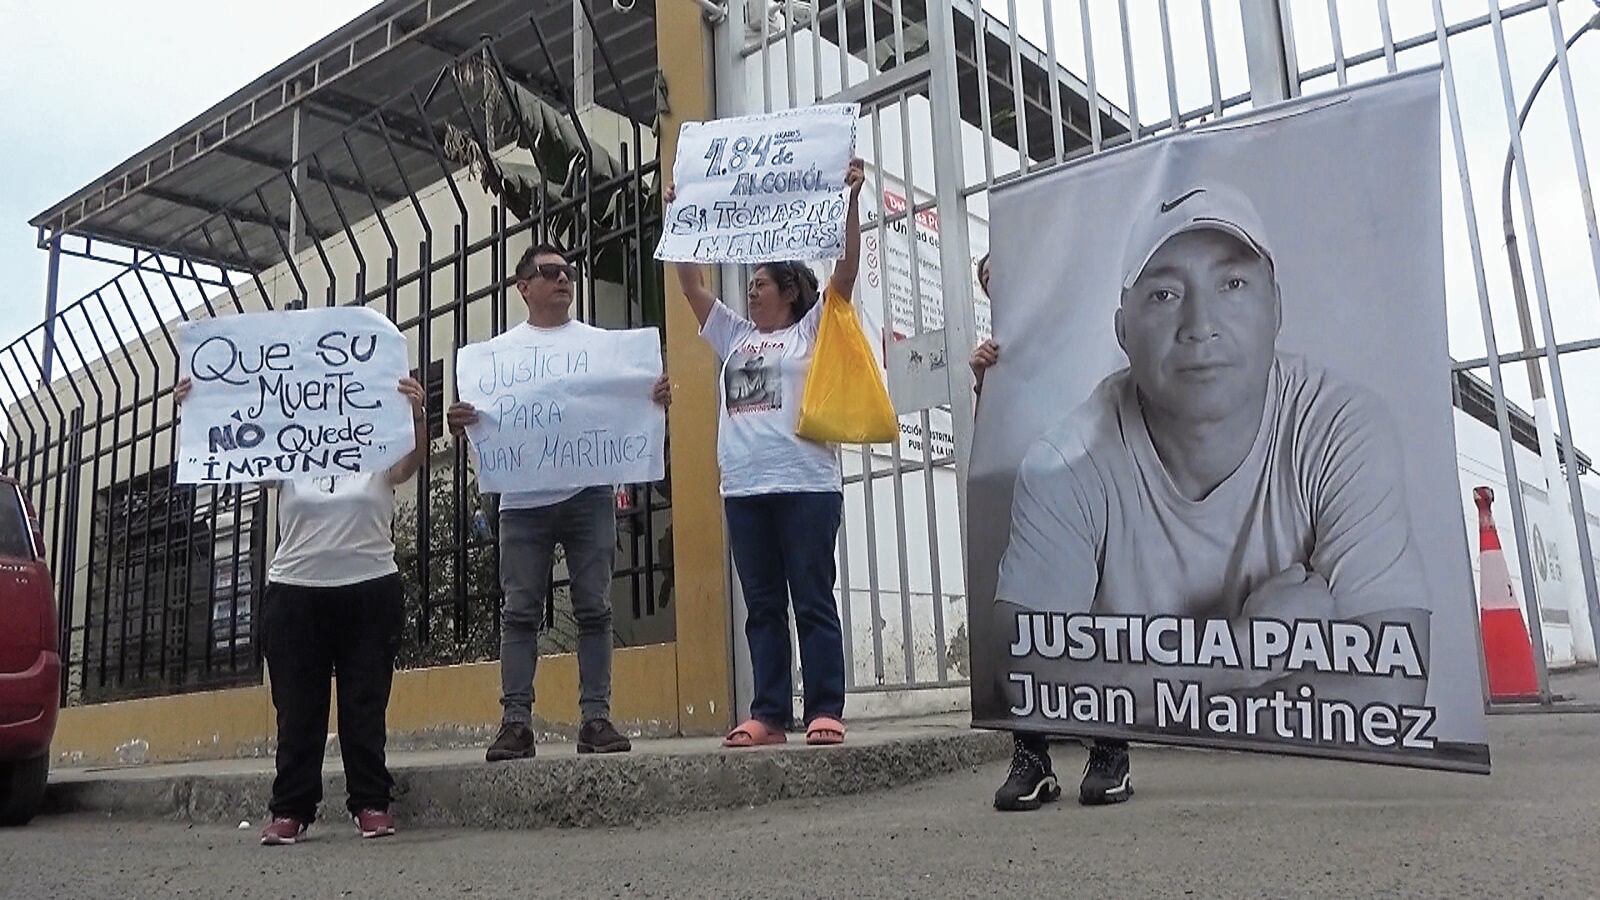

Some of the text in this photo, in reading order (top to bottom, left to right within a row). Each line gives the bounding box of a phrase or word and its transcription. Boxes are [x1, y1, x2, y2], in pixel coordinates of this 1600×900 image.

[704, 134, 773, 178] 1.84
[770, 145, 794, 166] de
[190, 330, 377, 386] Que SU
[276, 416, 375, 454] Quede
[492, 394, 562, 433] PARA
[474, 429, 653, 473] JUAN MARTINEZ
[1009, 612, 1426, 677] JUSTICIA PARA
[1008, 672, 1437, 749] Juan Martinez
